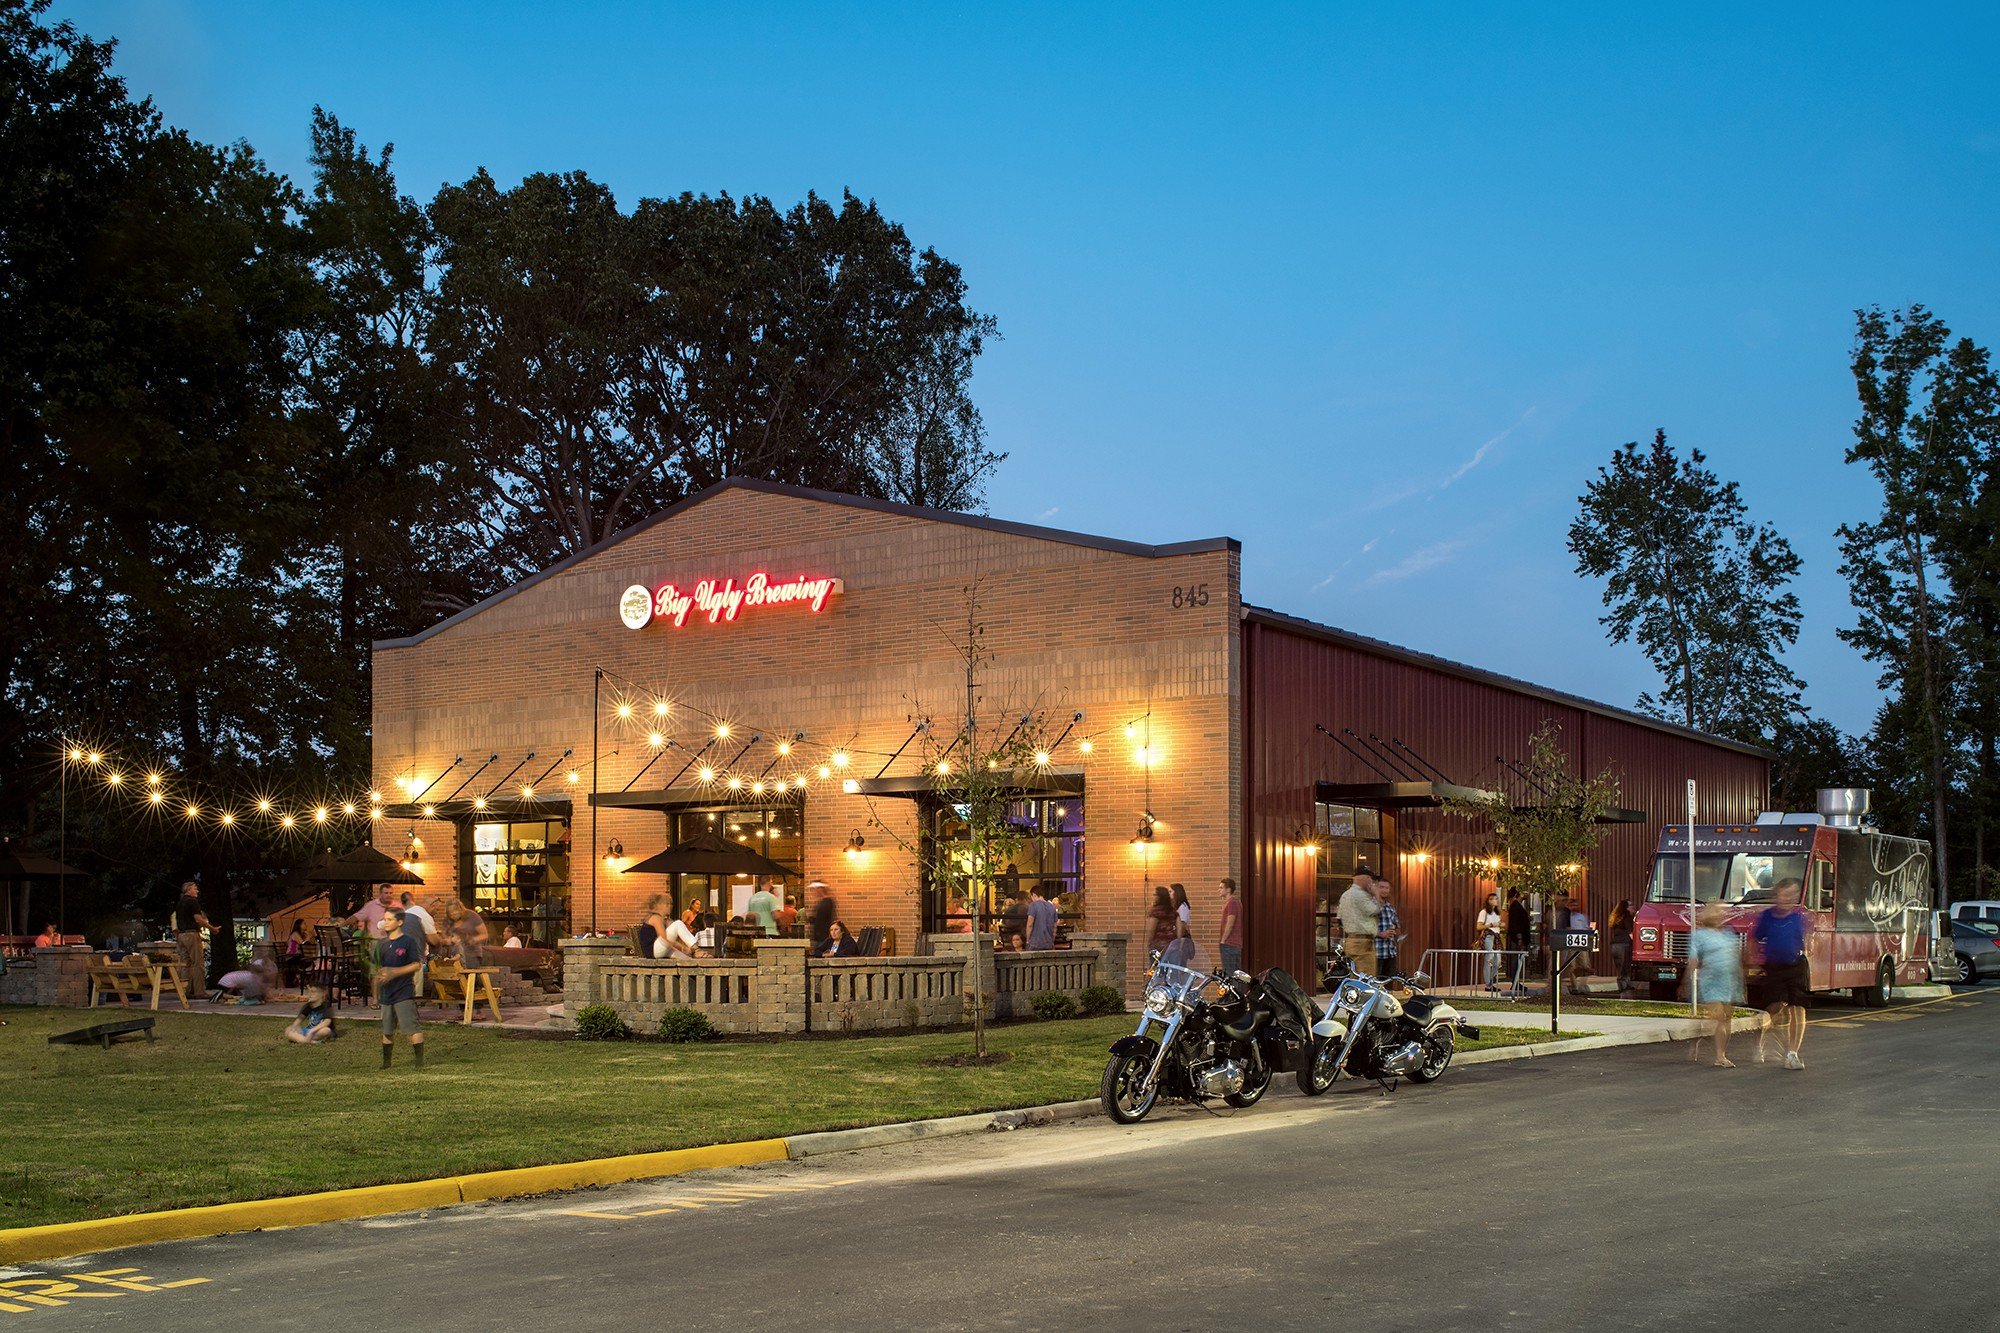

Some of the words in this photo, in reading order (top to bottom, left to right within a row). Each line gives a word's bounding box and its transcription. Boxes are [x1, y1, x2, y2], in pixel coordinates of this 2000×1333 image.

[654, 585, 693, 627] Big
[695, 579, 745, 623] Ugly
[745, 573, 834, 612] Brewing
[1172, 583, 1209, 608] 845
[1567, 934, 1587, 946] 845
